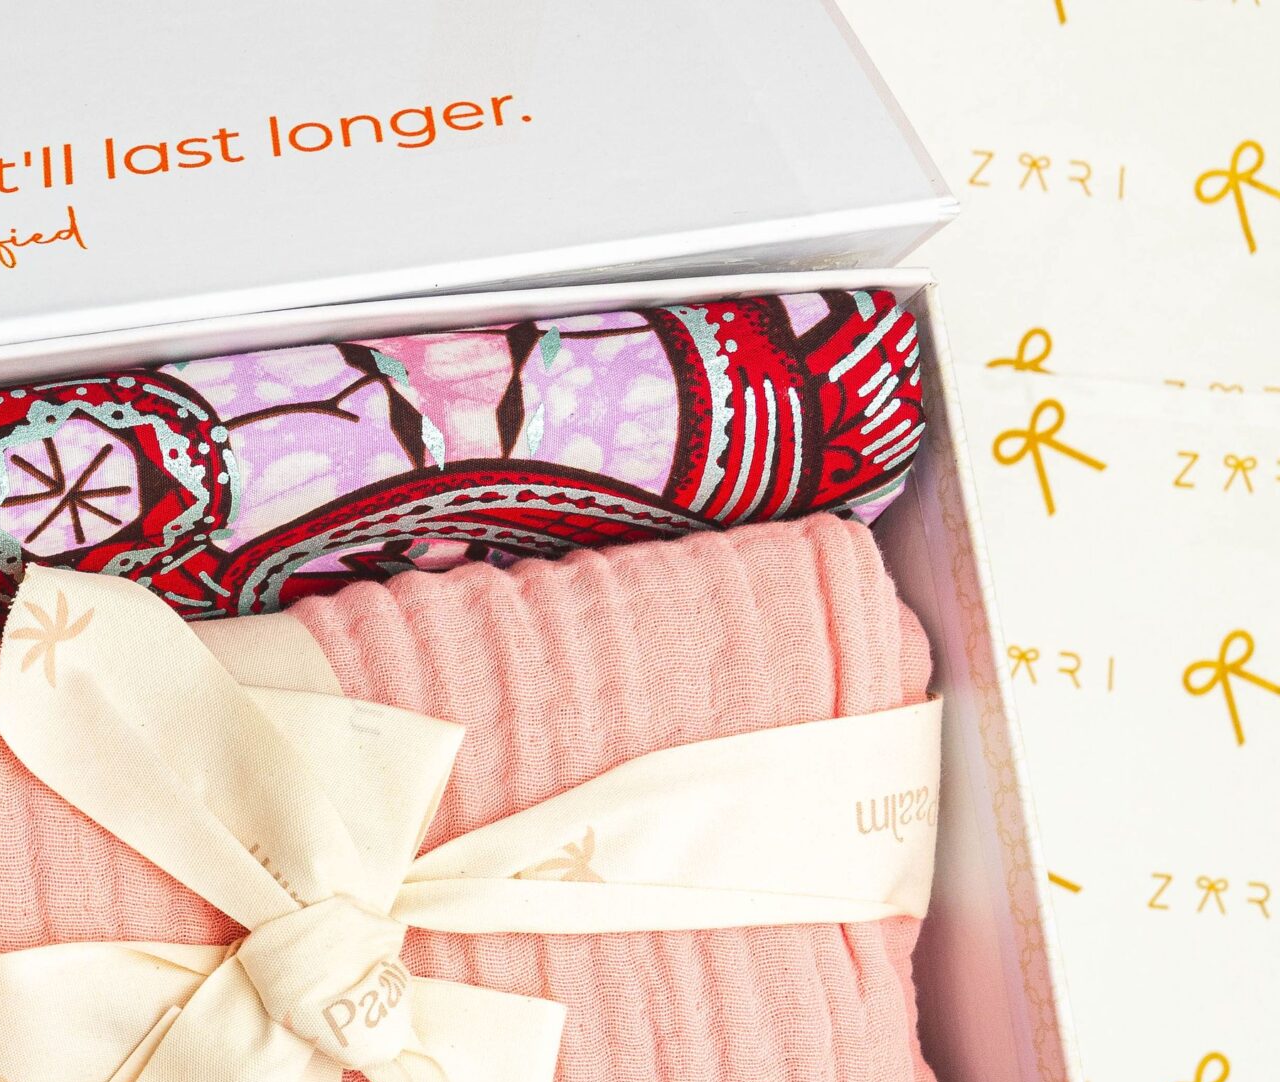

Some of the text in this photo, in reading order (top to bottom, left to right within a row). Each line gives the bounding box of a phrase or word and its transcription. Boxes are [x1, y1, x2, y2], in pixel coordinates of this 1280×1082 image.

[104, 128, 245, 179] last
[269, 94, 533, 149] longer.
[1006, 644, 1116, 691] ARI
[1147, 872, 1272, 919] ZAR
